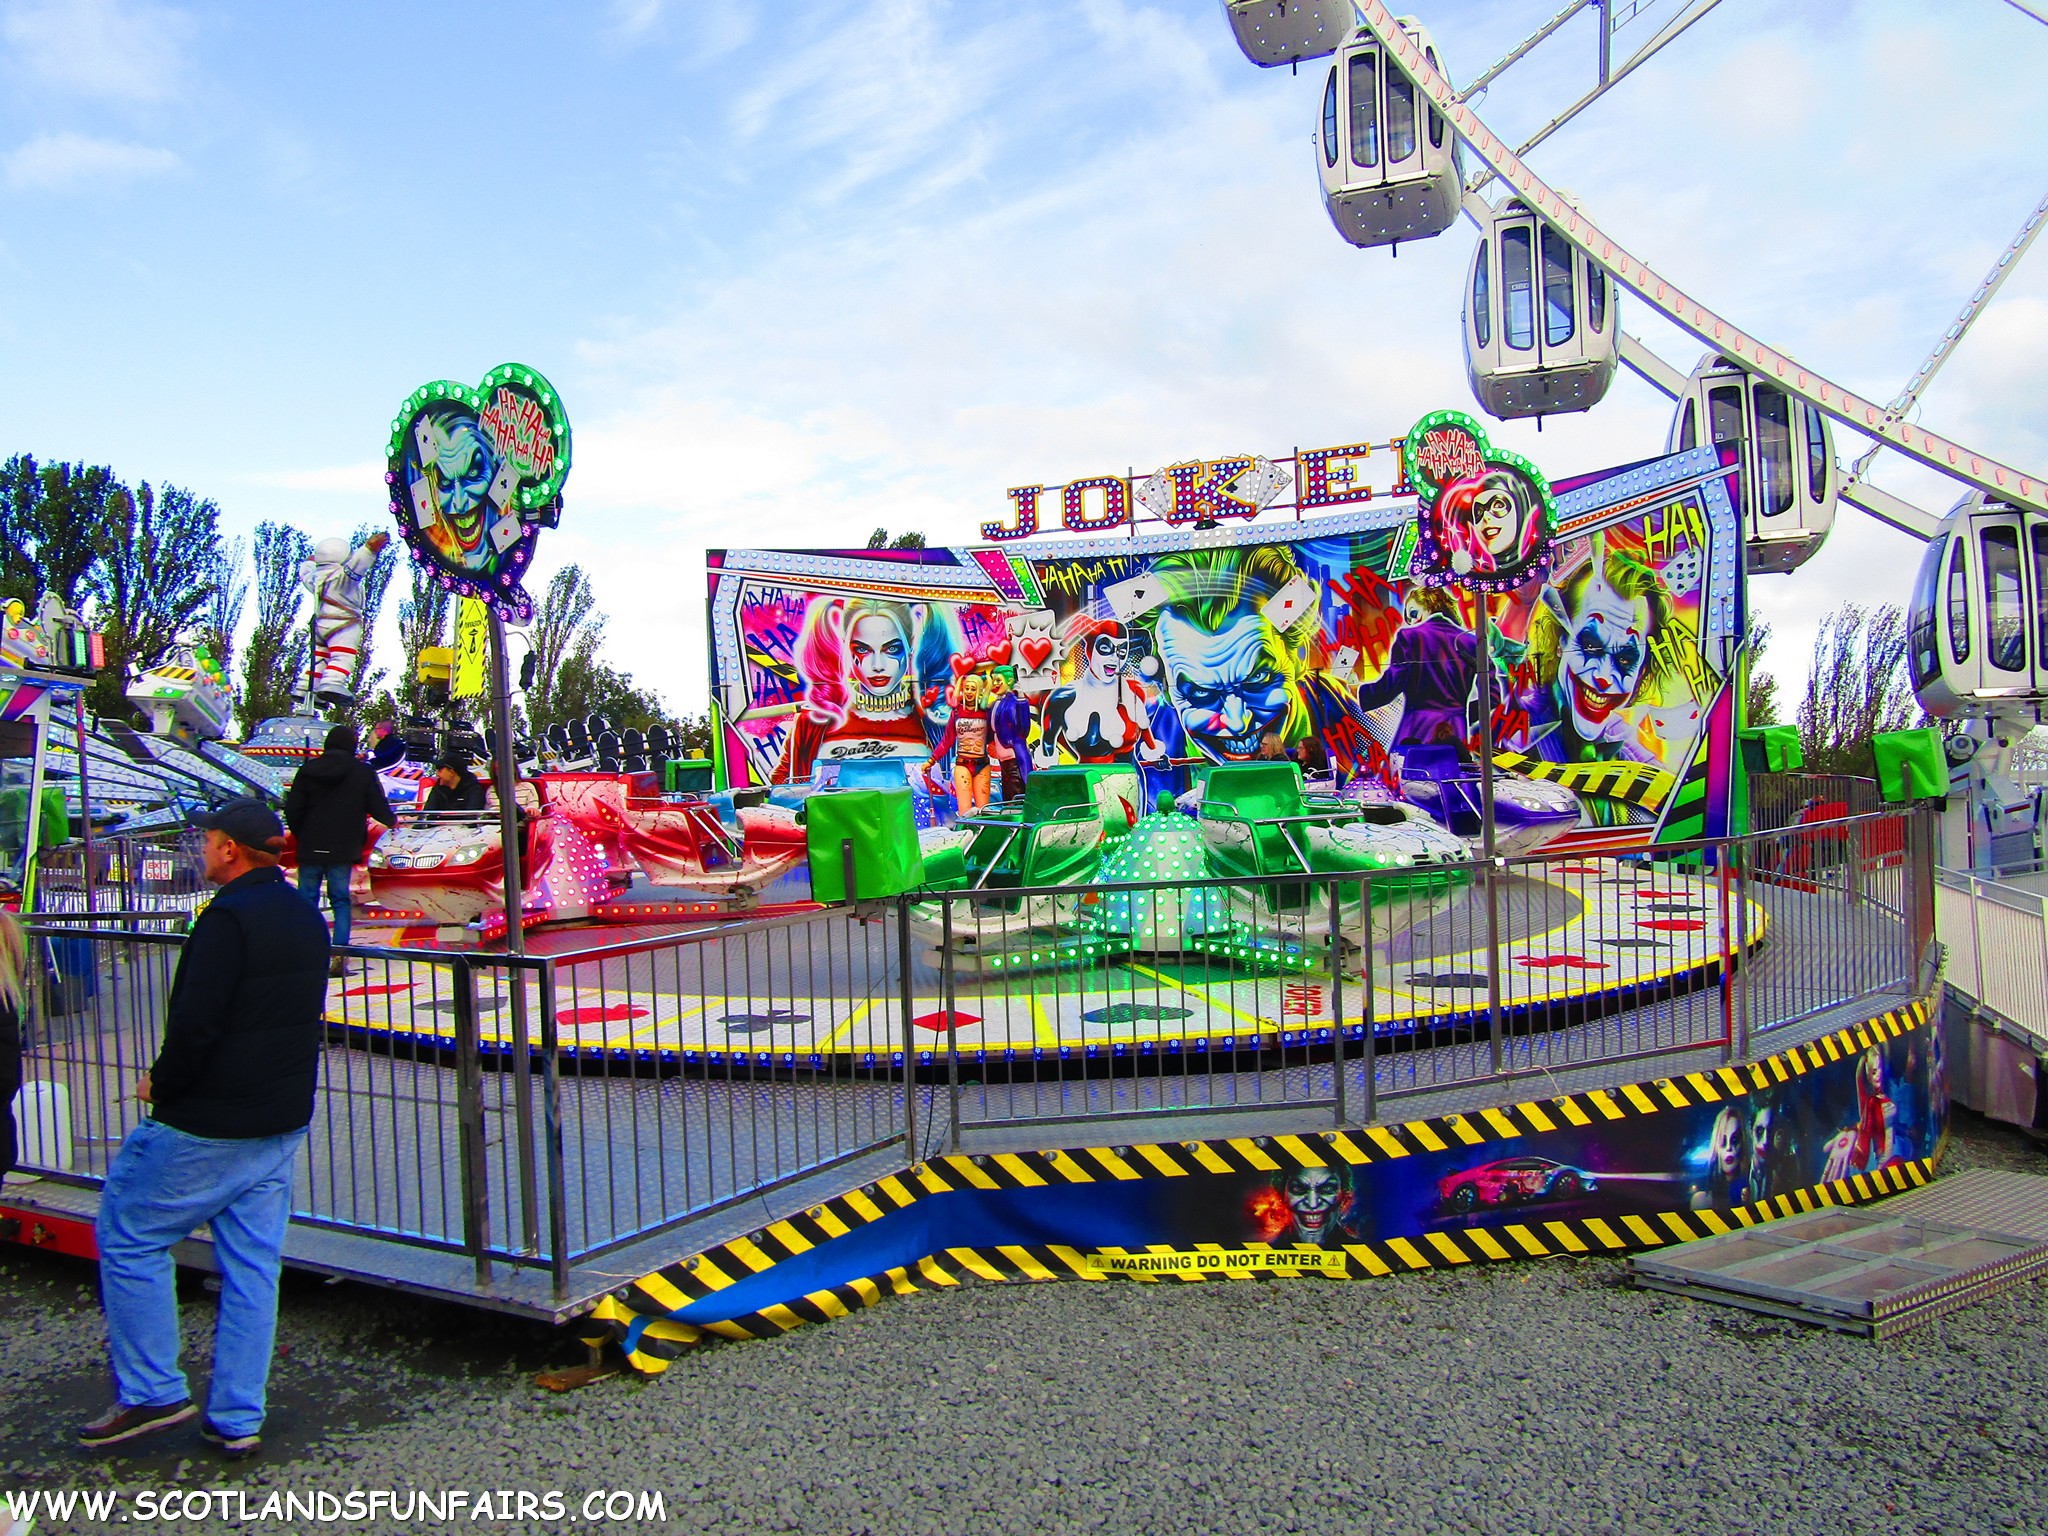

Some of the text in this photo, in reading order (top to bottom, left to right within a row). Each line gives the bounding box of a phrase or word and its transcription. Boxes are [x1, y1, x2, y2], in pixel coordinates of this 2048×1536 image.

[480, 401, 500, 434] HA
[496, 418, 518, 459] HA
[532, 438, 554, 479] HA
[498, 388, 520, 423] HA
[518, 399, 543, 451] HA
[1415, 446, 1433, 469] HA
[1430, 451, 1455, 479] HA
[1464, 450, 1486, 478] HA
[1425, 431, 1449, 453] HA
[1447, 429, 1467, 459] HA
[963, 611, 995, 648] HA
[1647, 618, 1698, 678] HA
[1508, 659, 1537, 698] HA
[1322, 715, 1373, 768] HA
[1491, 703, 1529, 747] HA
[1111, 1253, 1322, 1270] WARNING DO NOT ENTER
